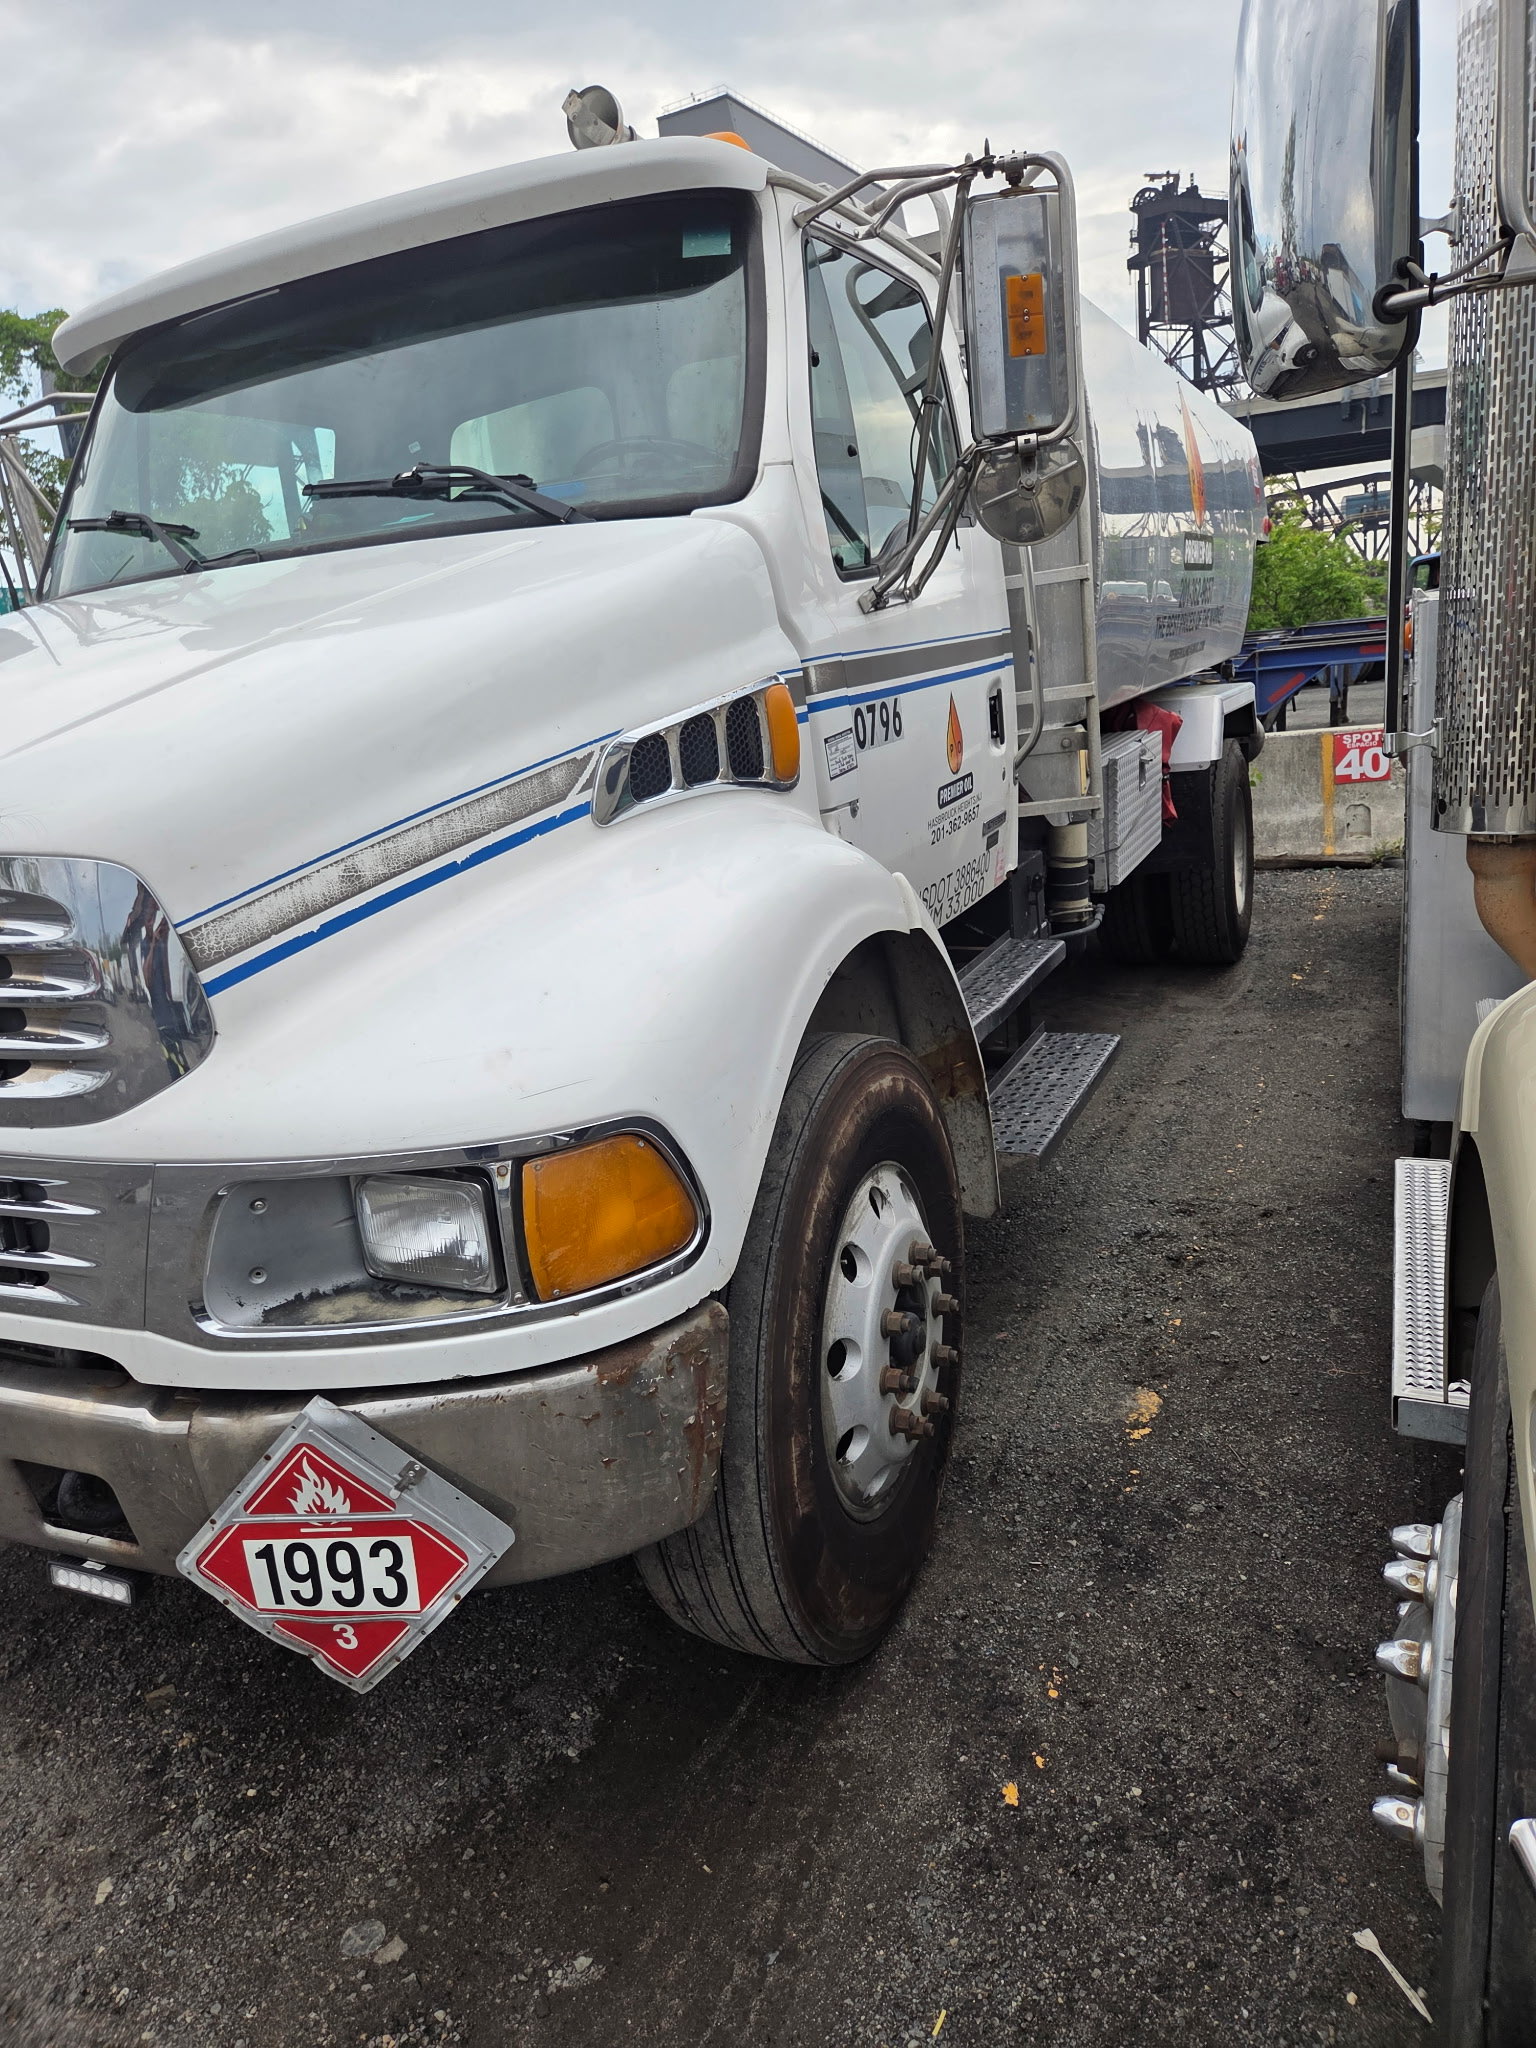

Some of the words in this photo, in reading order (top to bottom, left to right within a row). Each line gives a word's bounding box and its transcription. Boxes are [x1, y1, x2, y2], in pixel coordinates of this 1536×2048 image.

[854, 698, 902, 749] 0796
[1342, 731, 1382, 745] SPOT
[1335, 747, 1390, 780] 40
[940, 780, 963, 805] PREMIER
[931, 804, 980, 846] 201-362-9657
[920, 872, 953, 910] SDOT
[953, 849, 991, 893] 3886400
[946, 876, 985, 920] 33,000
[254, 1540, 409, 1608] 1993
[332, 1624, 359, 1650] 3
